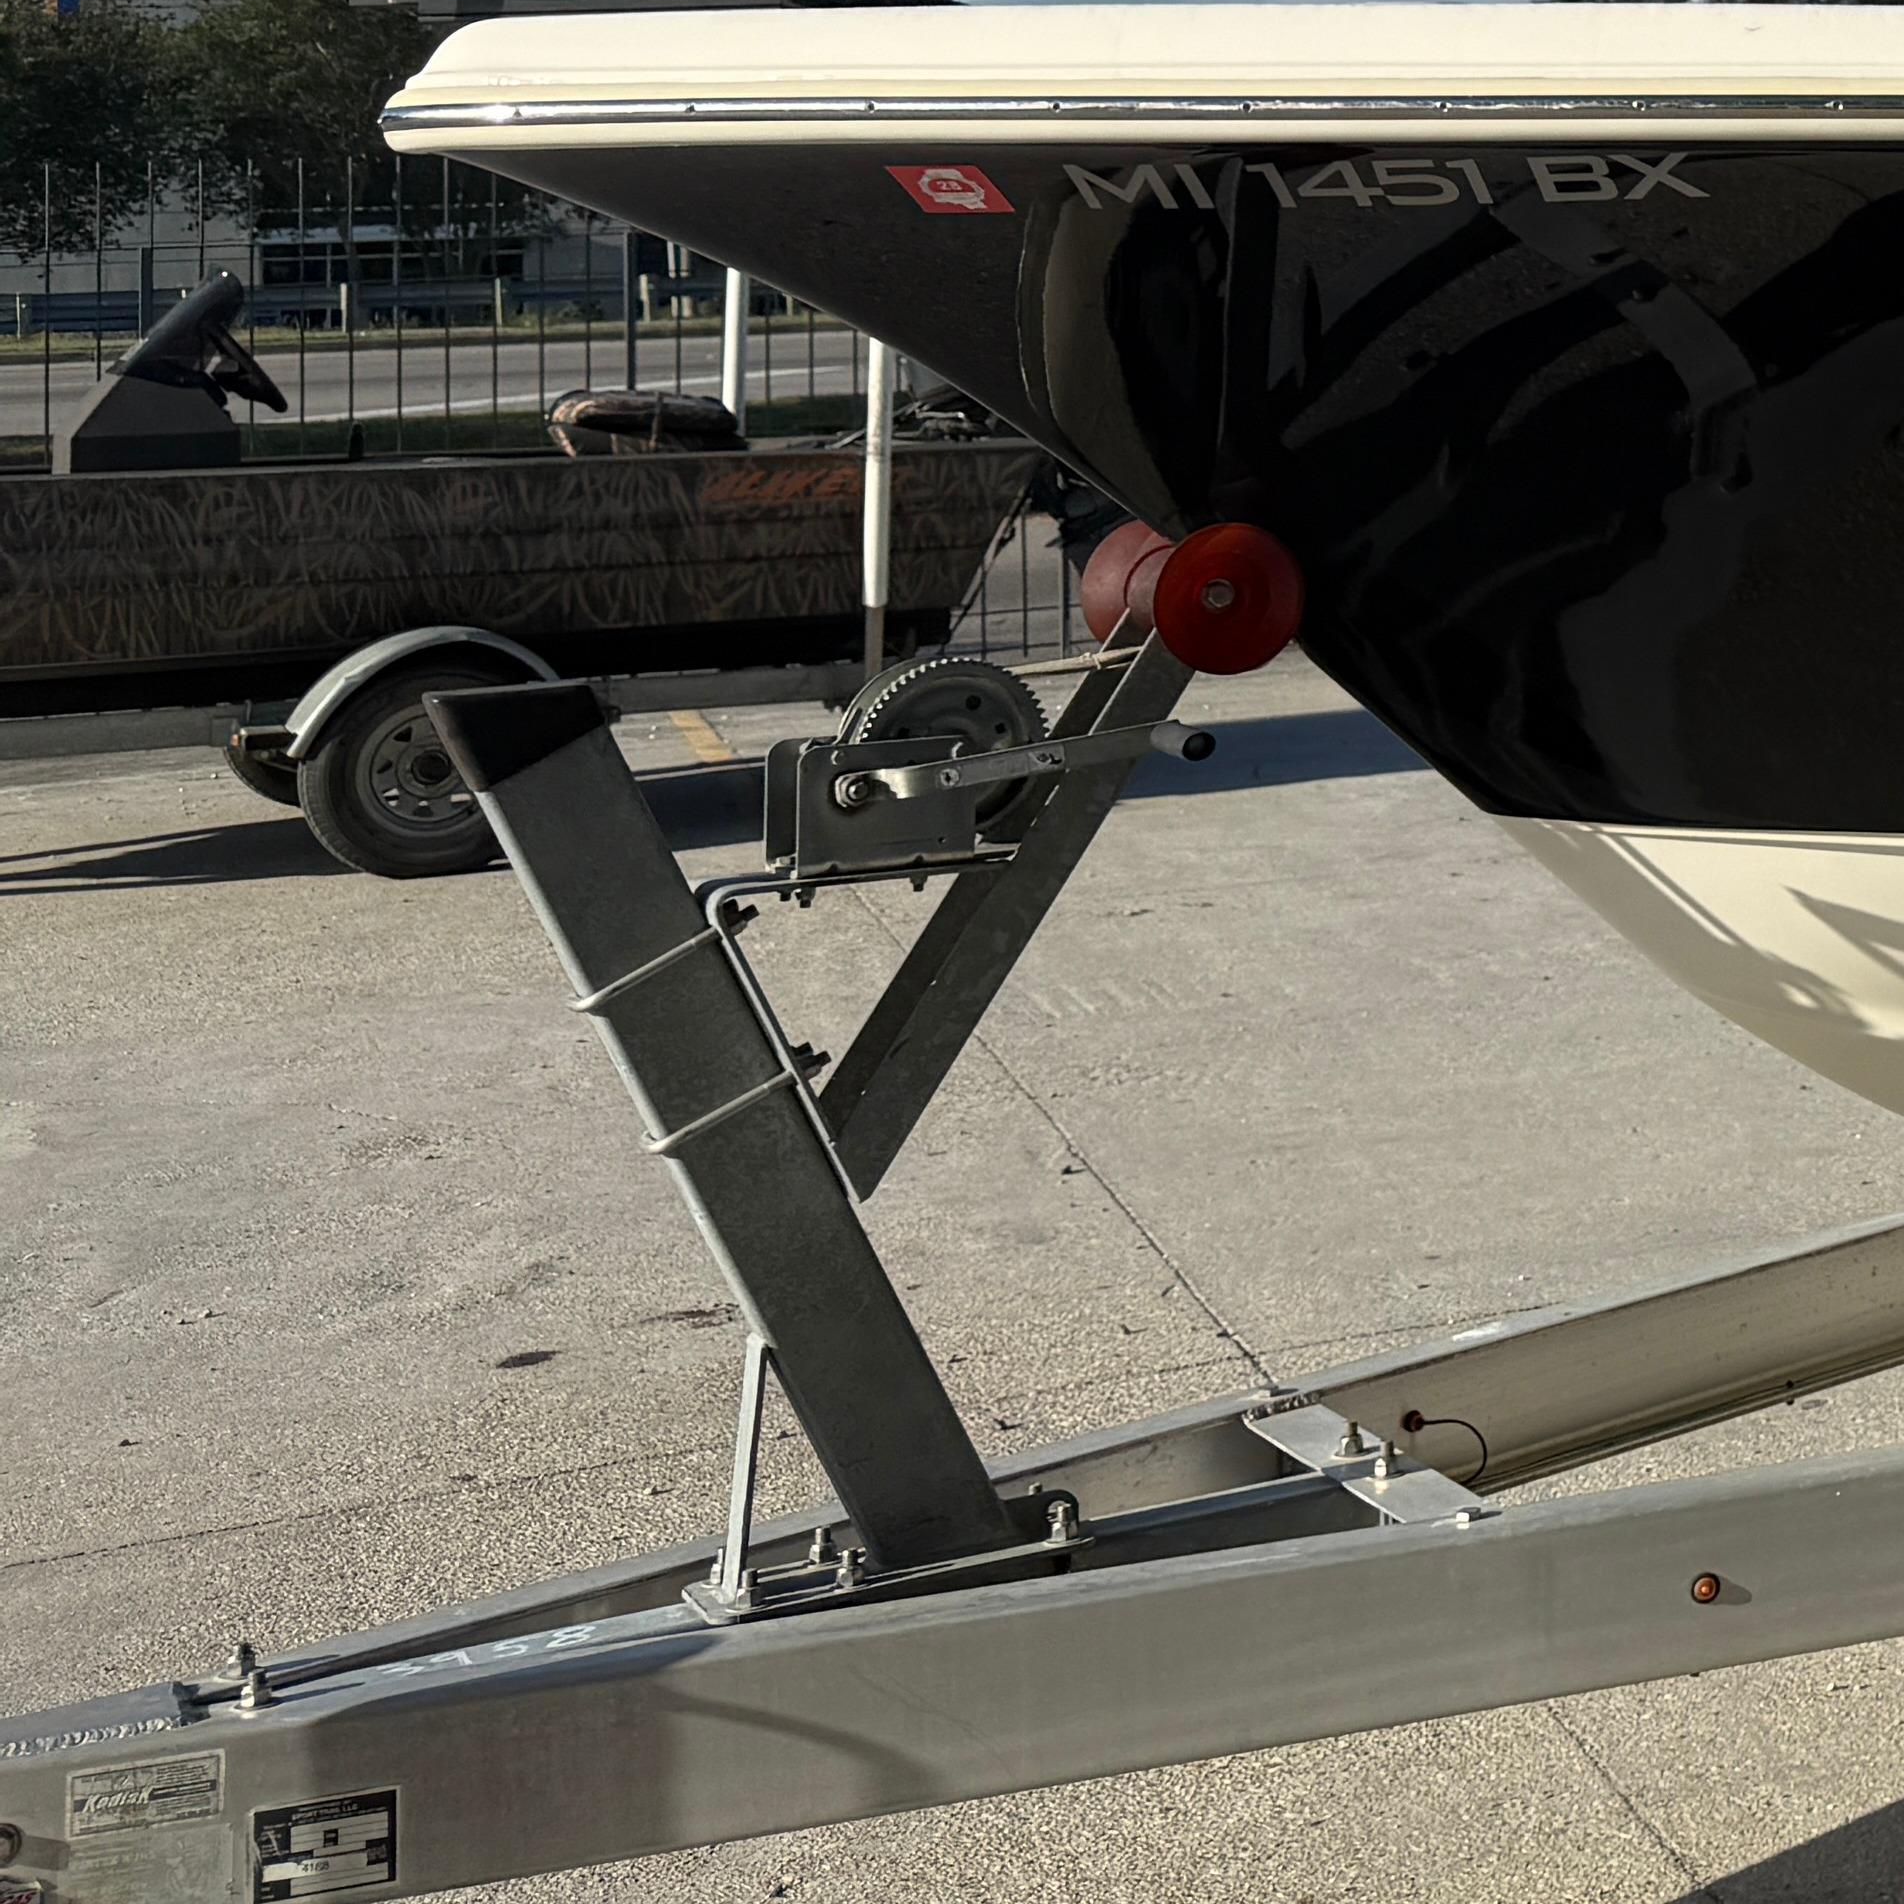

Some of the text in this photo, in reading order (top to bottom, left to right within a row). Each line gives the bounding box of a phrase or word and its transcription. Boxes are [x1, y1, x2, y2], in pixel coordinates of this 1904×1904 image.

[1062, 152, 1711, 209] MI 1451 BX
